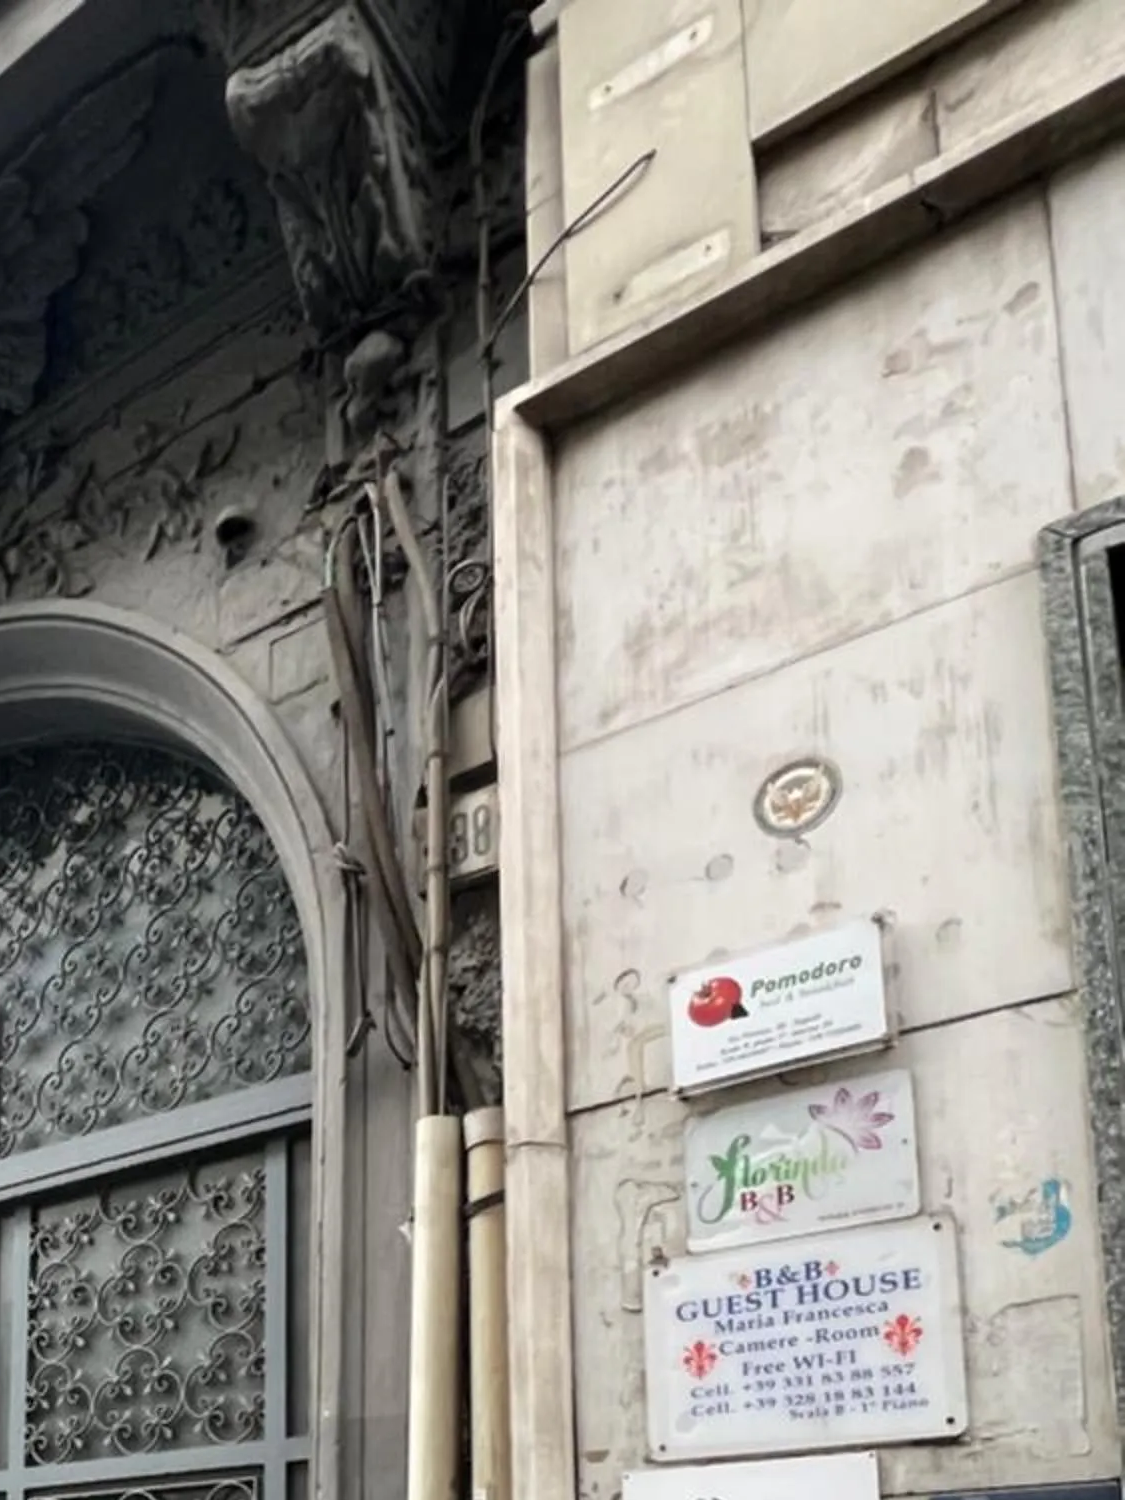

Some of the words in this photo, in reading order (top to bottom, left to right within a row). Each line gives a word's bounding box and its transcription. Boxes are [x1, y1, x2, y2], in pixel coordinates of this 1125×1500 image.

[750, 954, 863, 998] Pomodoro
[740, 1184, 796, 1224] B&B
[754, 1260, 824, 1289] B&B
[675, 1288, 785, 1322] GUEST
[797, 1268, 923, 1306] HOUSE
[714, 1316, 775, 1335] Maria
[783, 1300, 890, 1326] Francesca
[718, 1335, 799, 1357] Camere
[741, 1359, 786, 1377] Free
[793, 1350, 857, 1370] WI-FI
